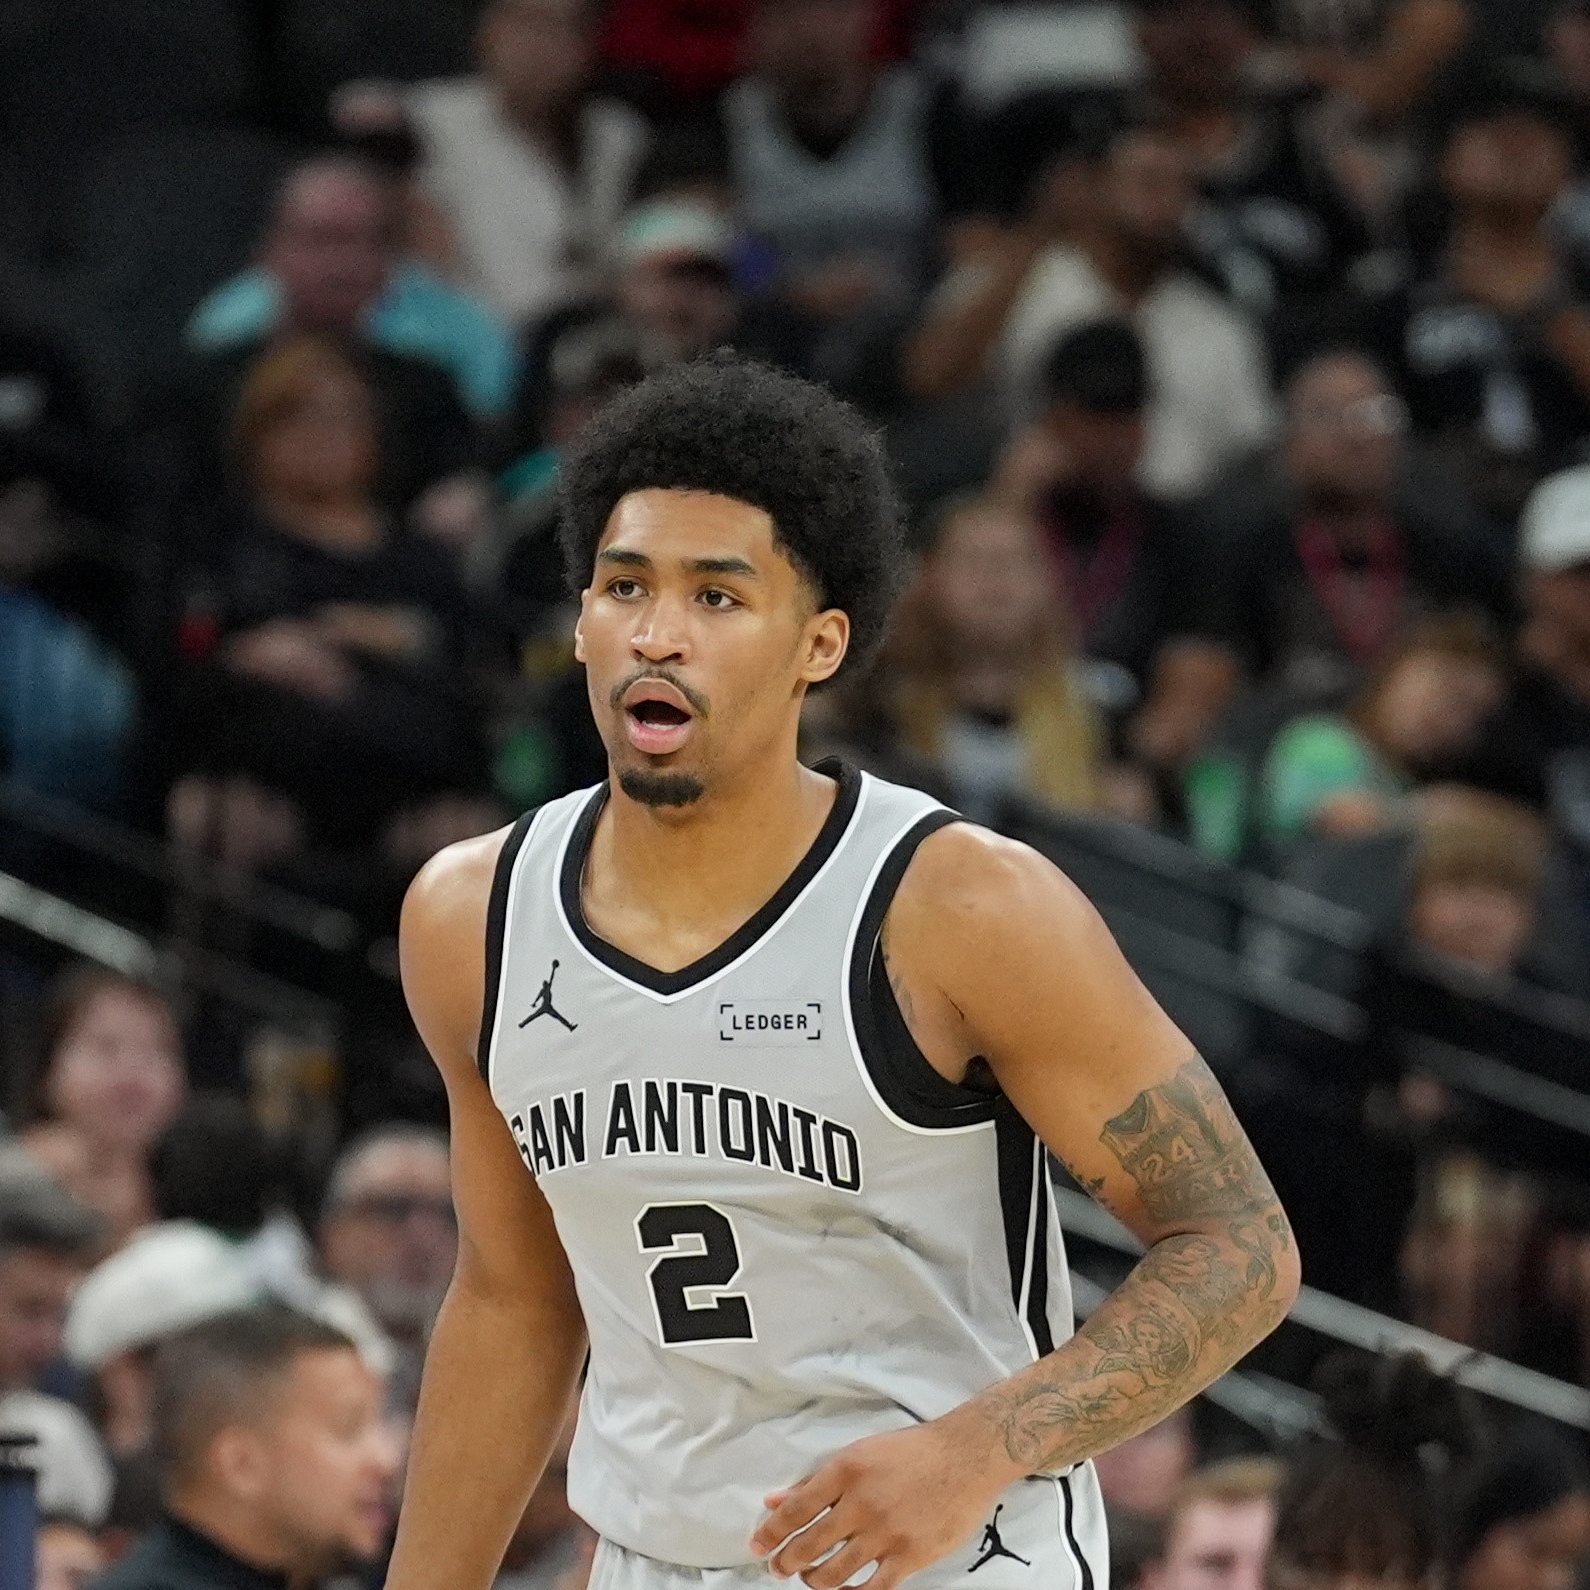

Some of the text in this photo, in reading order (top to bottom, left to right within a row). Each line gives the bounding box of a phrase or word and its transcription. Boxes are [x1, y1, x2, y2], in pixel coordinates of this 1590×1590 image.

[731, 1013, 809, 1031] LEDGER
[509, 1078, 863, 1196] SAN ANTONIO
[633, 1200, 758, 1349] 2
